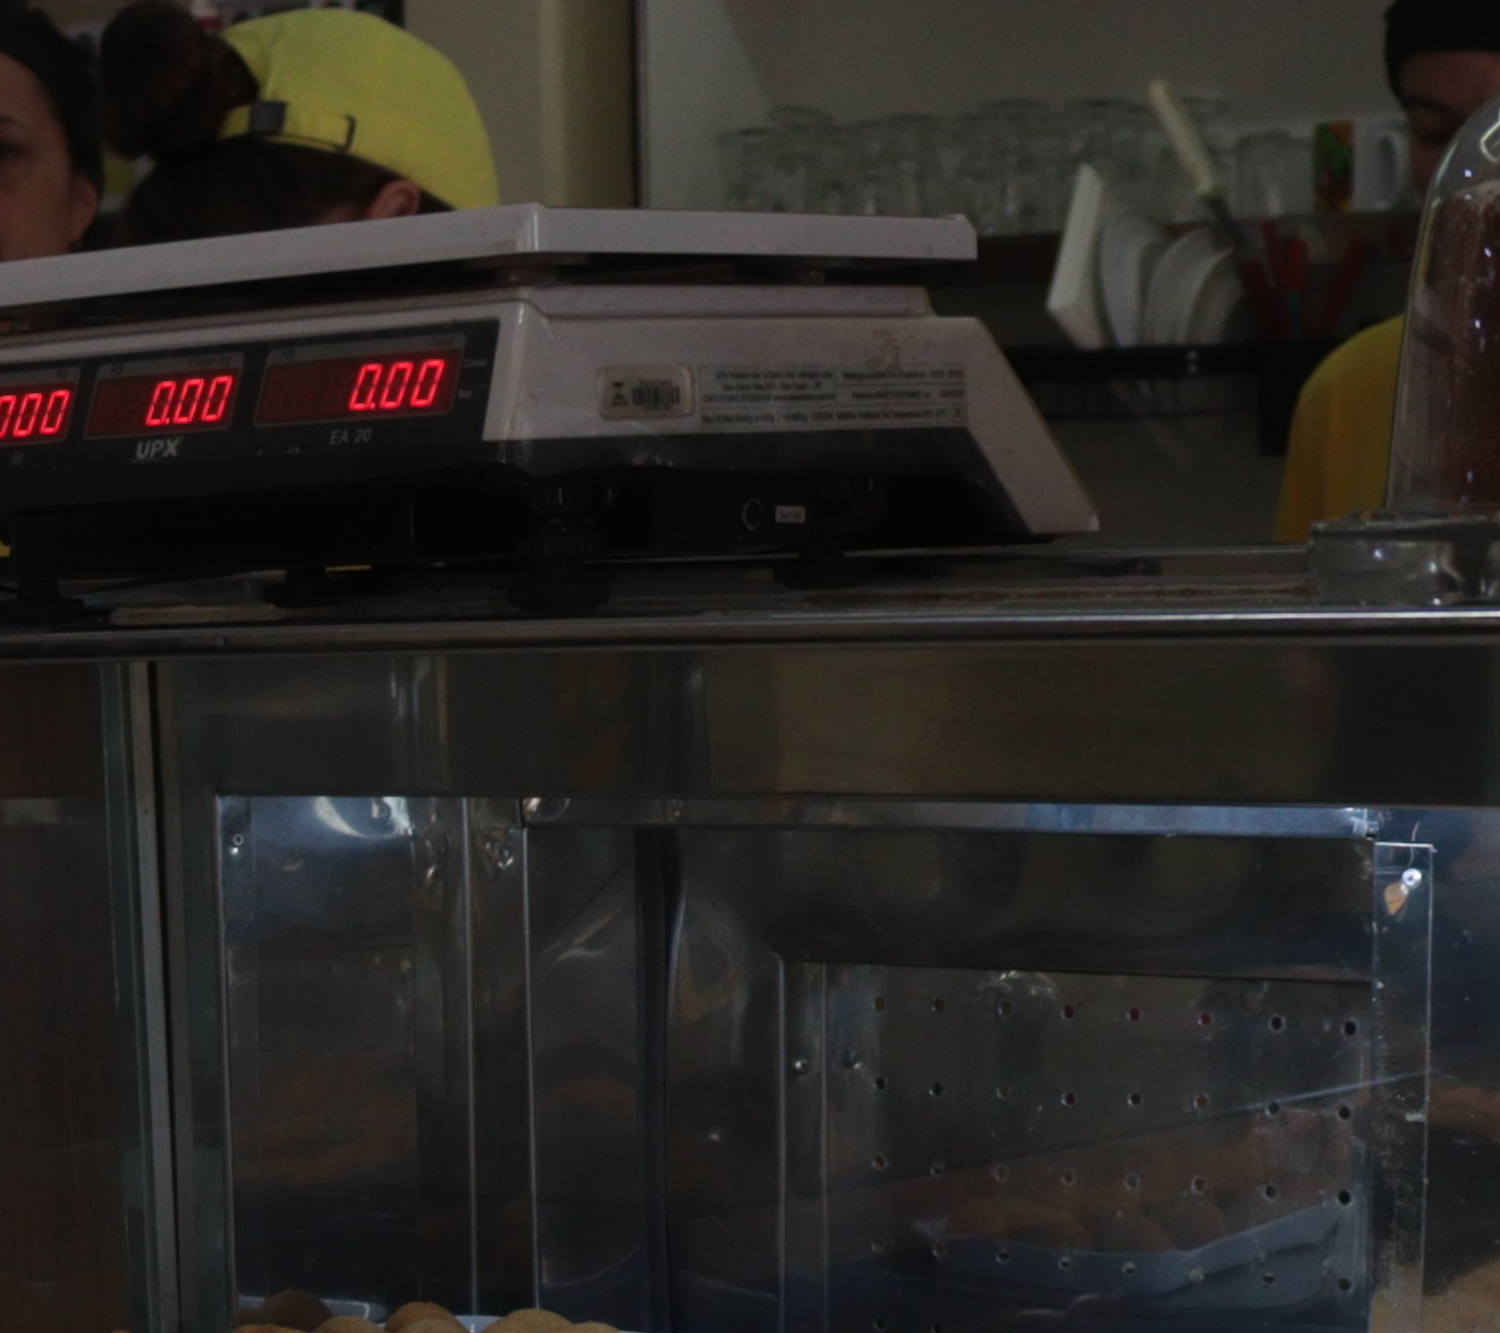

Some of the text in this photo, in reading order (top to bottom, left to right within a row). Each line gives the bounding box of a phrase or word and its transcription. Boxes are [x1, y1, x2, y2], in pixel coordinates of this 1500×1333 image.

[145, 375, 232, 427] 0.00
[348, 359, 444, 411] 0.00
[136, 438, 179, 459] UPX
[330, 428, 372, 444] EA 20
